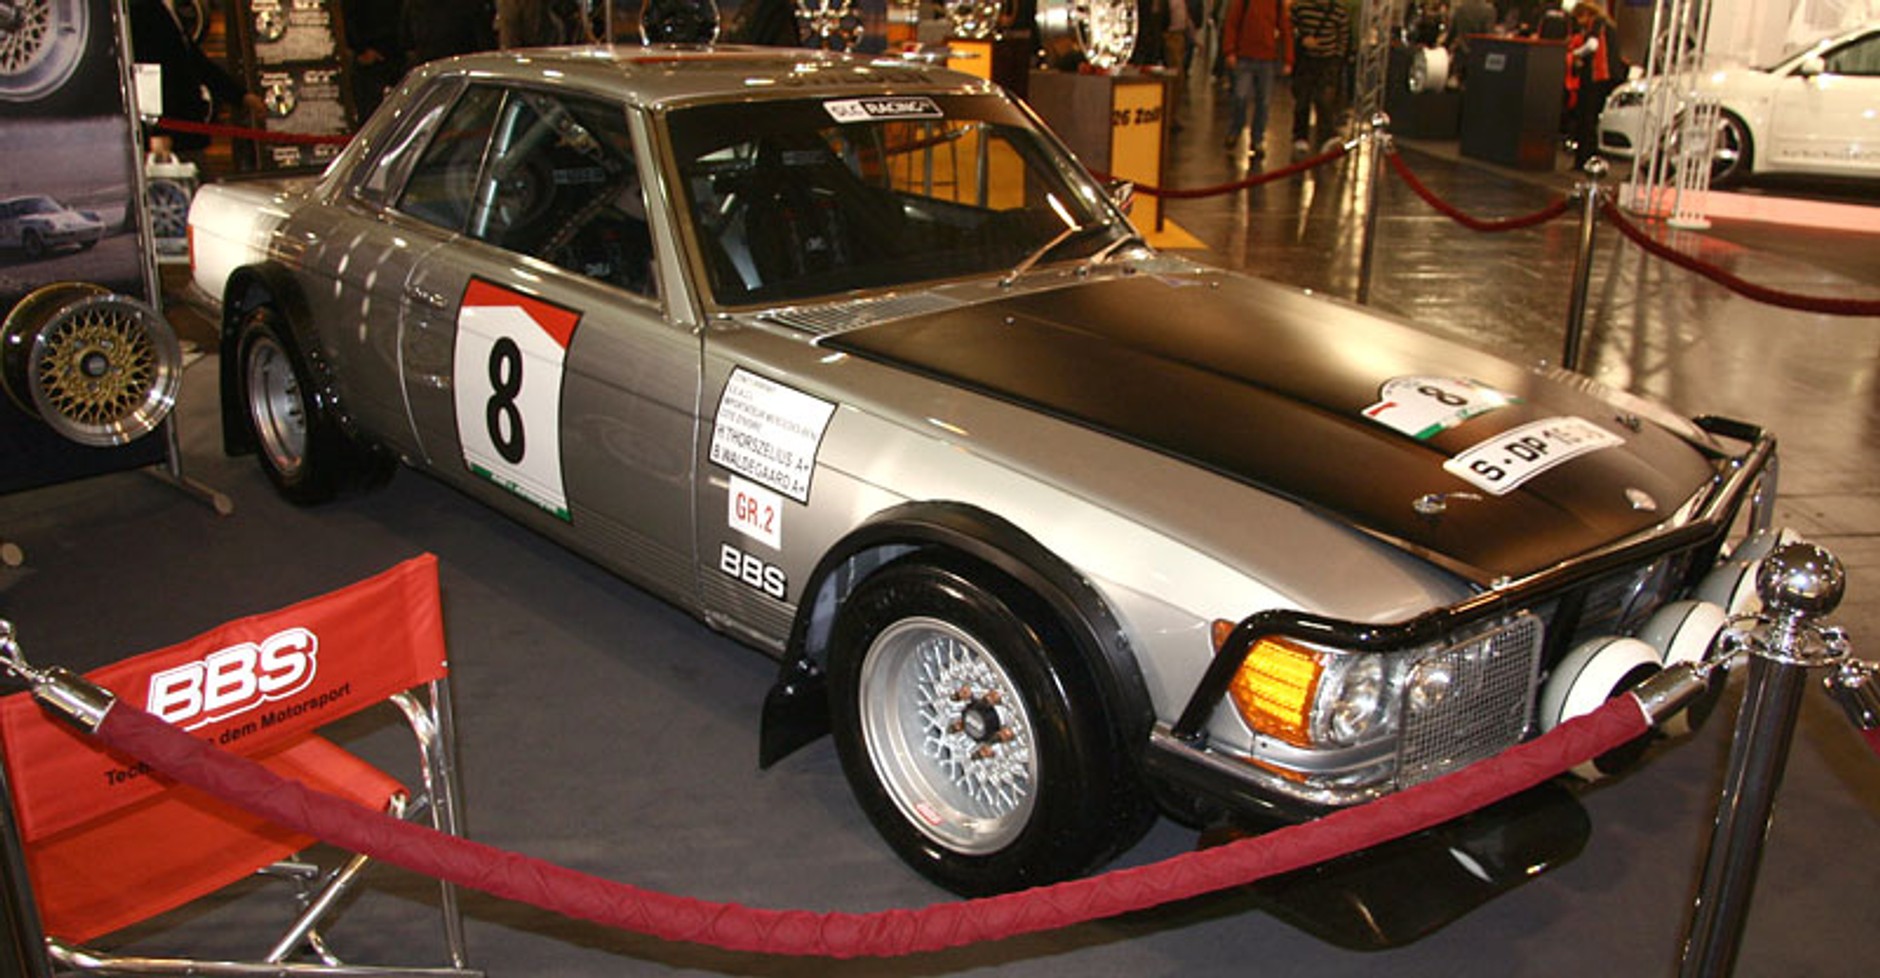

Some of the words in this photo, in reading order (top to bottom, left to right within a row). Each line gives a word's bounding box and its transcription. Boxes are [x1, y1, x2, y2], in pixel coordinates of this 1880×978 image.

[487, 336, 526, 465] 8
[1417, 385, 1468, 406] 8
[736, 491, 775, 534] GR.2
[720, 542, 787, 600] BBS
[147, 627, 318, 731] BBS
[104, 760, 150, 786] Tech
[219, 724, 257, 746] dem
[261, 682, 352, 728] Motorsport
